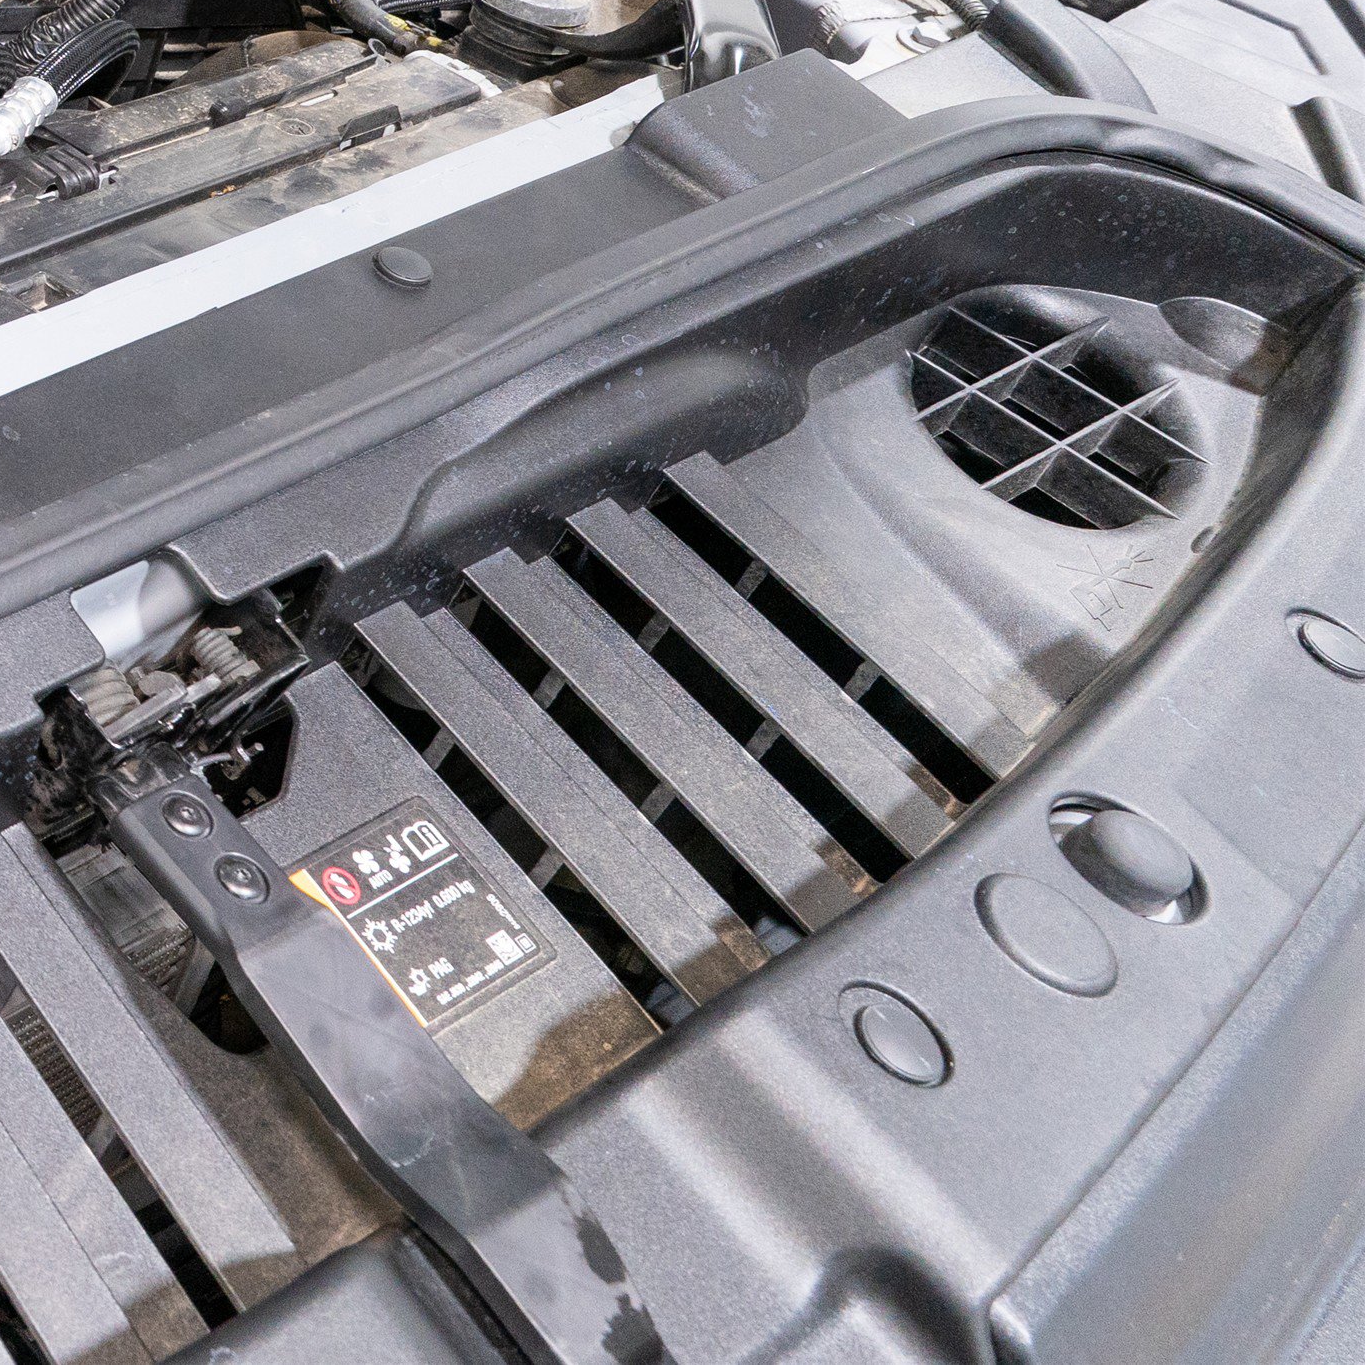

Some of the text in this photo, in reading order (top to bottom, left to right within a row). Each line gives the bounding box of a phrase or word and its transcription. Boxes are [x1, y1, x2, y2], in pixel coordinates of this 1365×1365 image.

[368, 869, 394, 890] AUTO
[455, 879, 476, 894] kg
[427, 956, 455, 980] PAG
